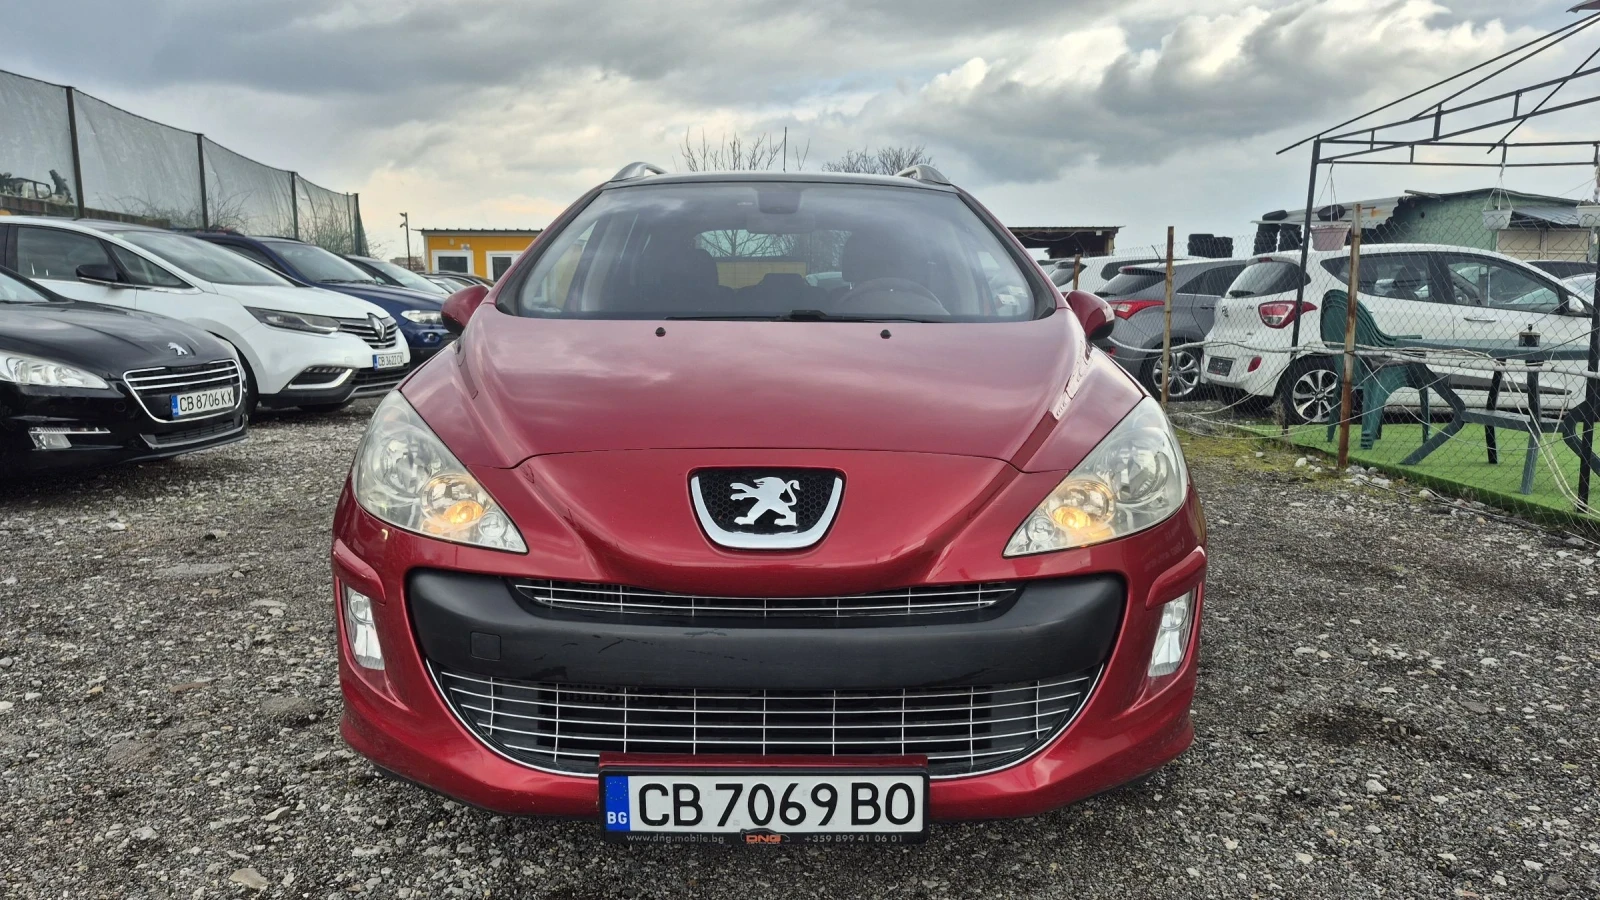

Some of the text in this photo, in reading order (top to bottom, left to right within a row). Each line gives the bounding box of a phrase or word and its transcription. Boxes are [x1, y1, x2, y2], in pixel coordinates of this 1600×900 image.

[378, 356, 385, 366] CB
[180, 396, 194, 411] CB
[196, 391, 220, 409] 8706
[221, 389, 232, 405] KX
[639, 782, 915, 827] CB 7069 BO
[607, 812, 627, 824] BG
[627, 834, 724, 844] www.dng.mobile.bg
[746, 834, 781, 842] DNG
[805, 834, 902, 843] +359 899 41 06 01
